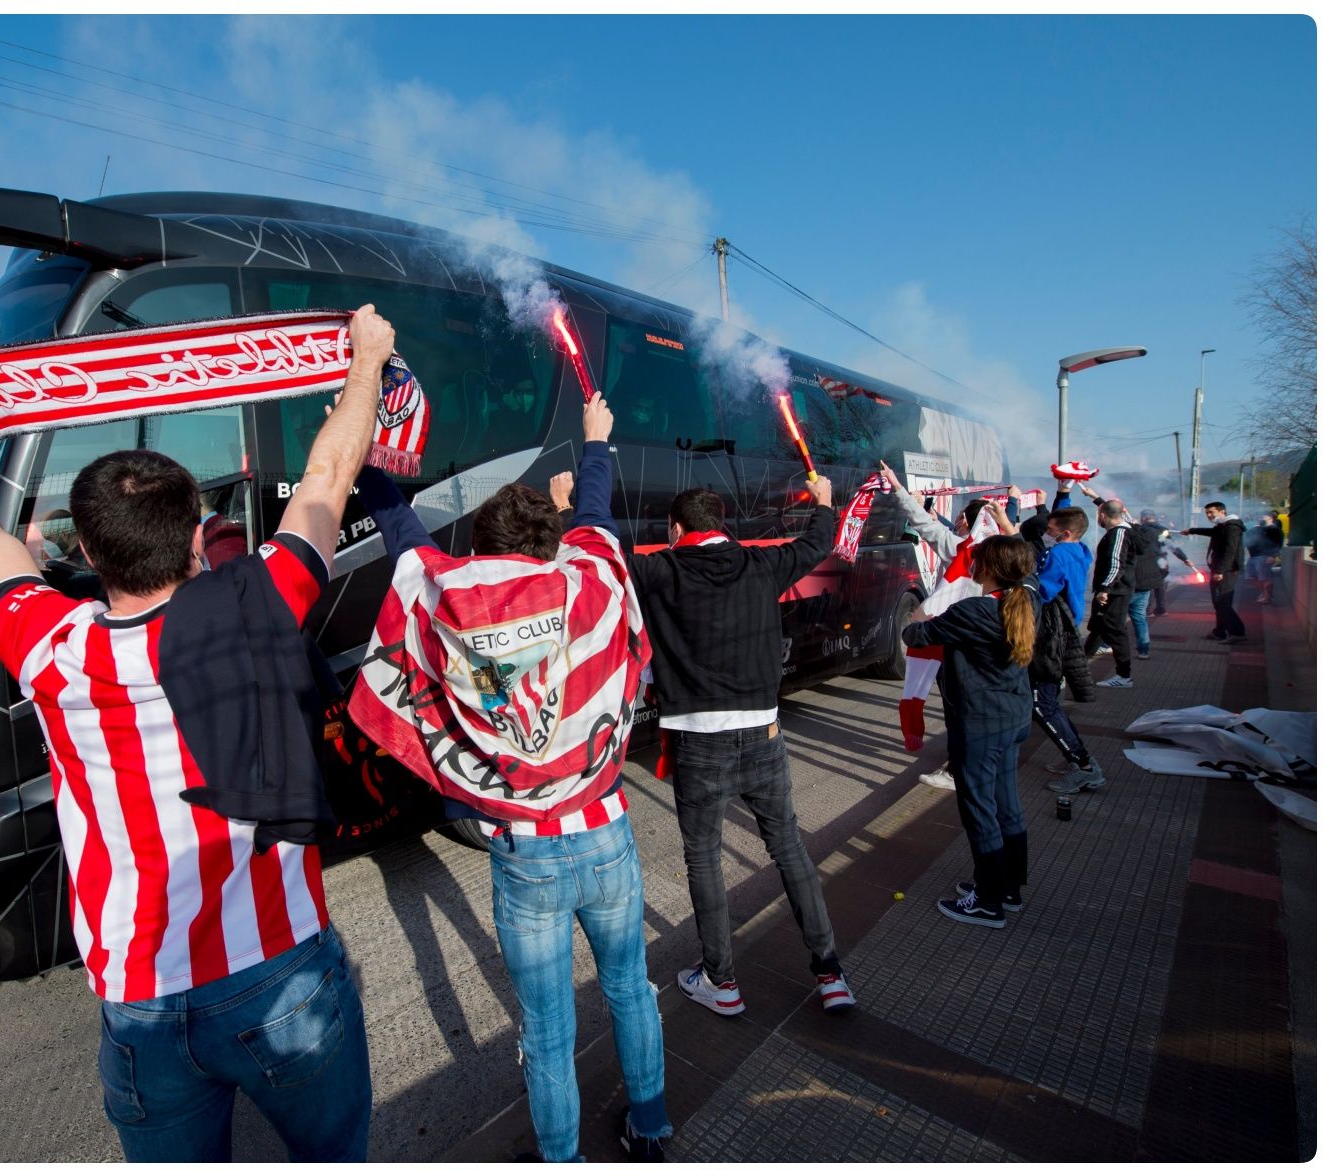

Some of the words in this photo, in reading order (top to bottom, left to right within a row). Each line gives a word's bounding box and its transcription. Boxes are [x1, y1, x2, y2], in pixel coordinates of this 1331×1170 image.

[908, 459, 934, 472] ATHLETIC
[350, 515, 377, 539] PB
[517, 615, 563, 640] CLUB
[489, 686, 559, 755] BILBAO
